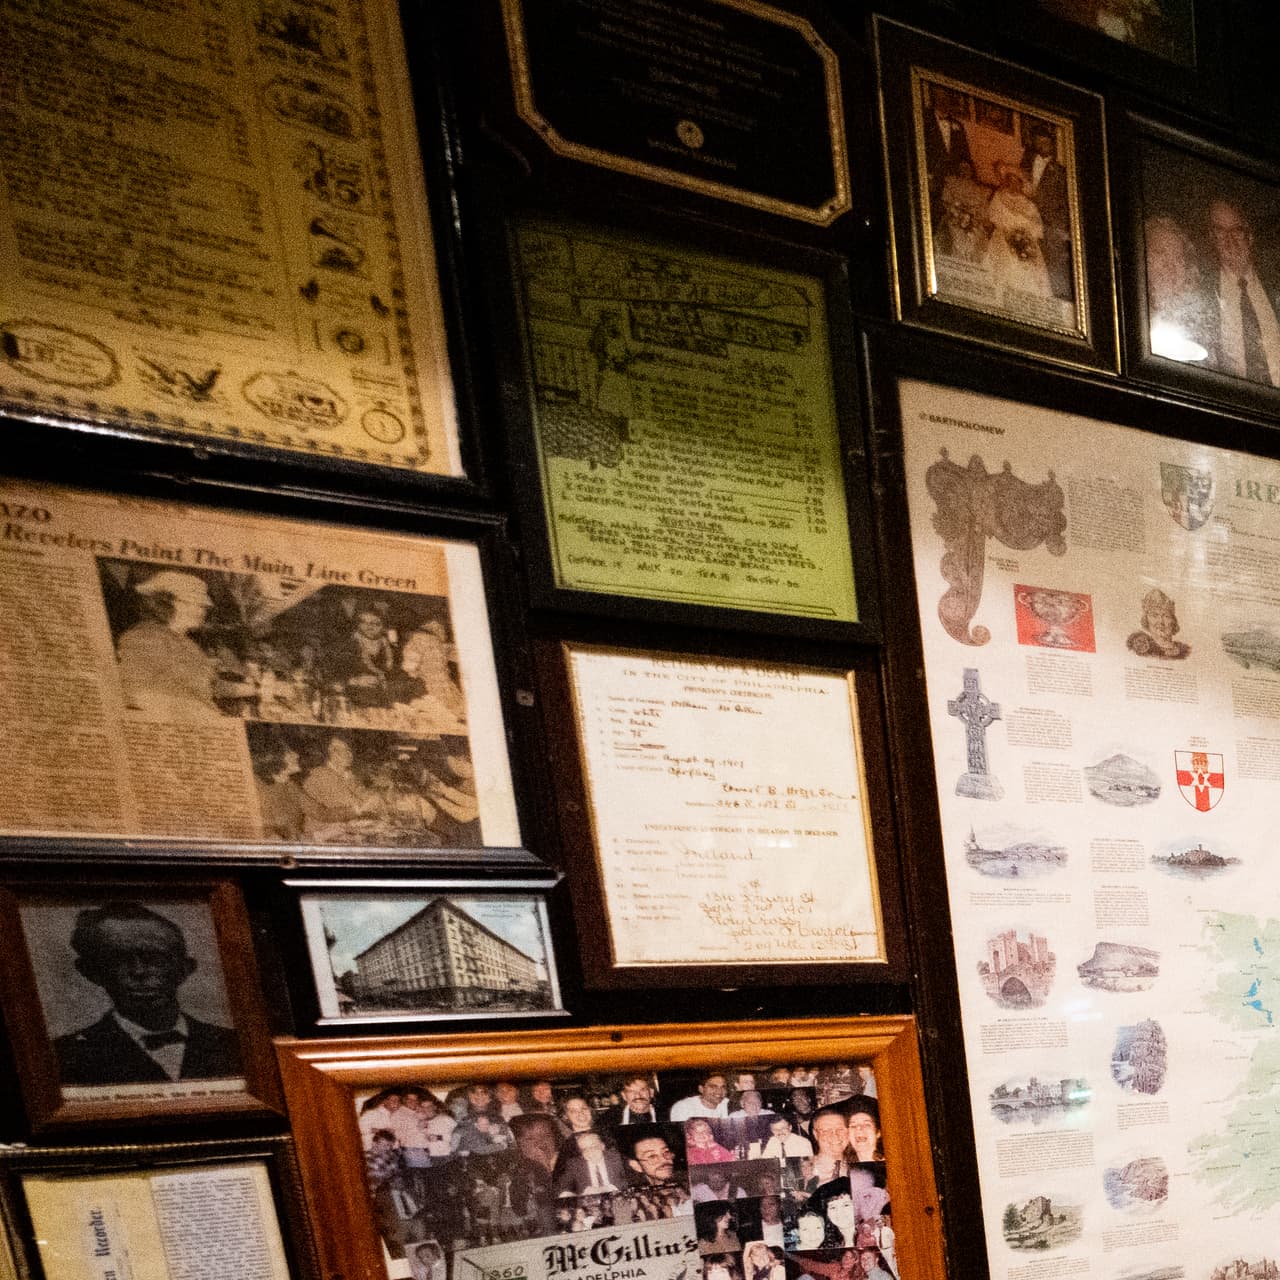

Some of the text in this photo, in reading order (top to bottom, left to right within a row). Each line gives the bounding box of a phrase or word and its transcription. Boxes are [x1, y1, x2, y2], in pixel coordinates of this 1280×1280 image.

[3, 527, 417, 590] Revelers Paint The Main Line Green
[542, 1233, 699, 1276] McGillin's
